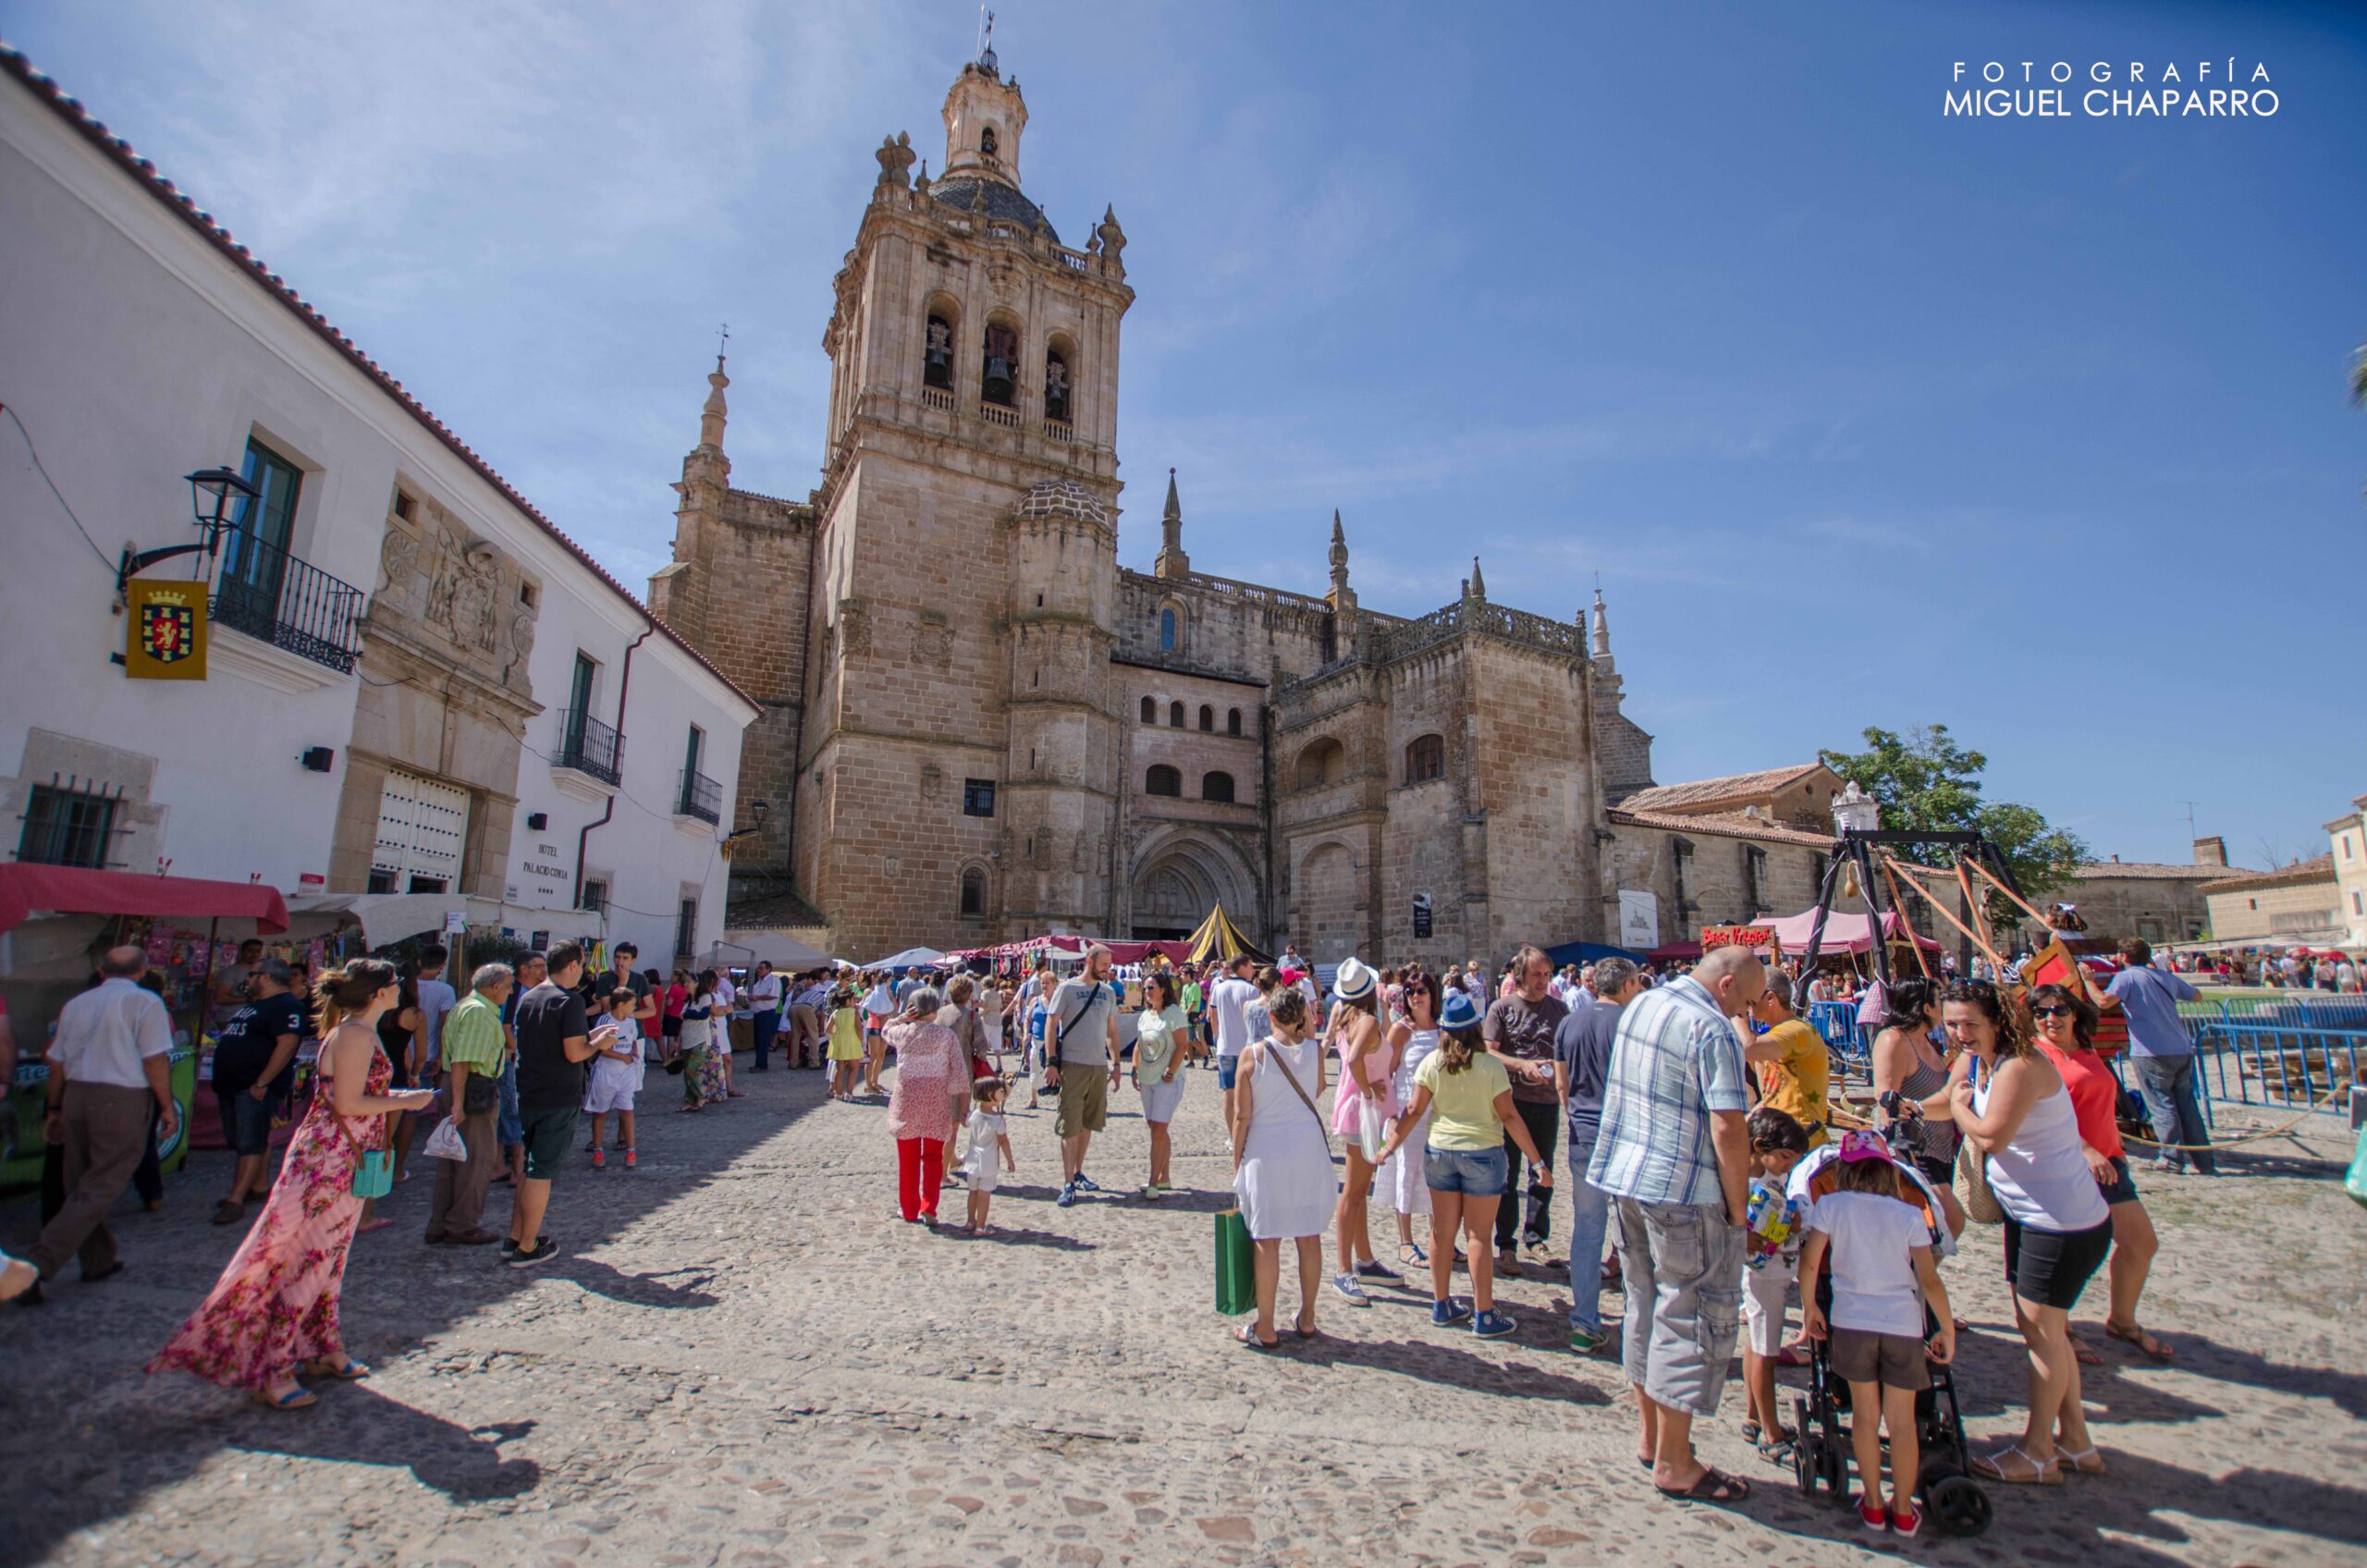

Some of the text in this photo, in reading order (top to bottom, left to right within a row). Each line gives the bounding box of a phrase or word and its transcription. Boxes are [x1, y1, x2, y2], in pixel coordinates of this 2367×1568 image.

[538, 843, 558, 857] HOTEL
[523, 862, 568, 880] PALACIO CORIA
[288, 1013, 300, 1028] 3
